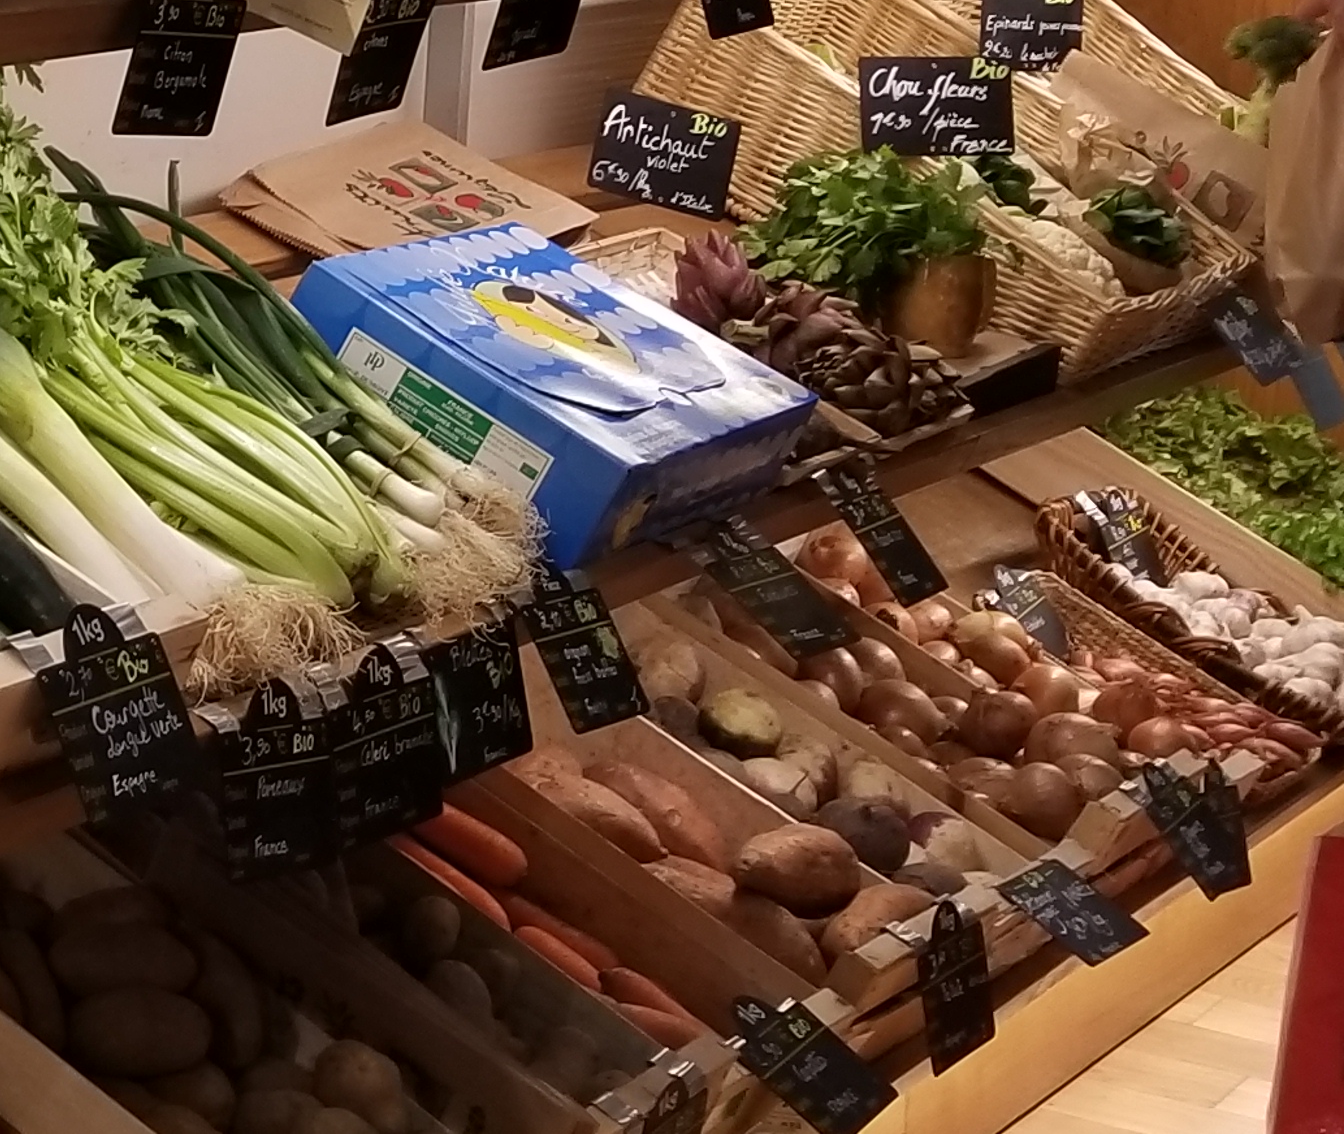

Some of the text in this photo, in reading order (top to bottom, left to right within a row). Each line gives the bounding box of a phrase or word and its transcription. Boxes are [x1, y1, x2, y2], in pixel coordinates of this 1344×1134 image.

[205, 5, 225, 28] Bio
[985, 14, 1035, 37] Epinards
[164, 41, 193, 63] Citron
[363, 34, 389, 51] citrons
[153, 64, 207, 95] Bergamote
[969, 57, 1011, 80] Bio
[869, 66, 988, 116] Chou fleurs
[602, 104, 715, 159] Artichaut
[689, 113, 728, 138] Bio
[949, 135, 1013, 154] France
[647, 154, 690, 173] violet
[72, 613, 105, 646] 1kg
[117, 649, 149, 684] Bio
[367, 656, 392, 685] 1kg
[91, 686, 166, 734] Courgette
[261, 688, 287, 718] 1kg
[241, 736, 271, 766] 3,90
[112, 769, 158, 797] Espagne
[365, 795, 400, 820] France
[254, 834, 288, 859] France
